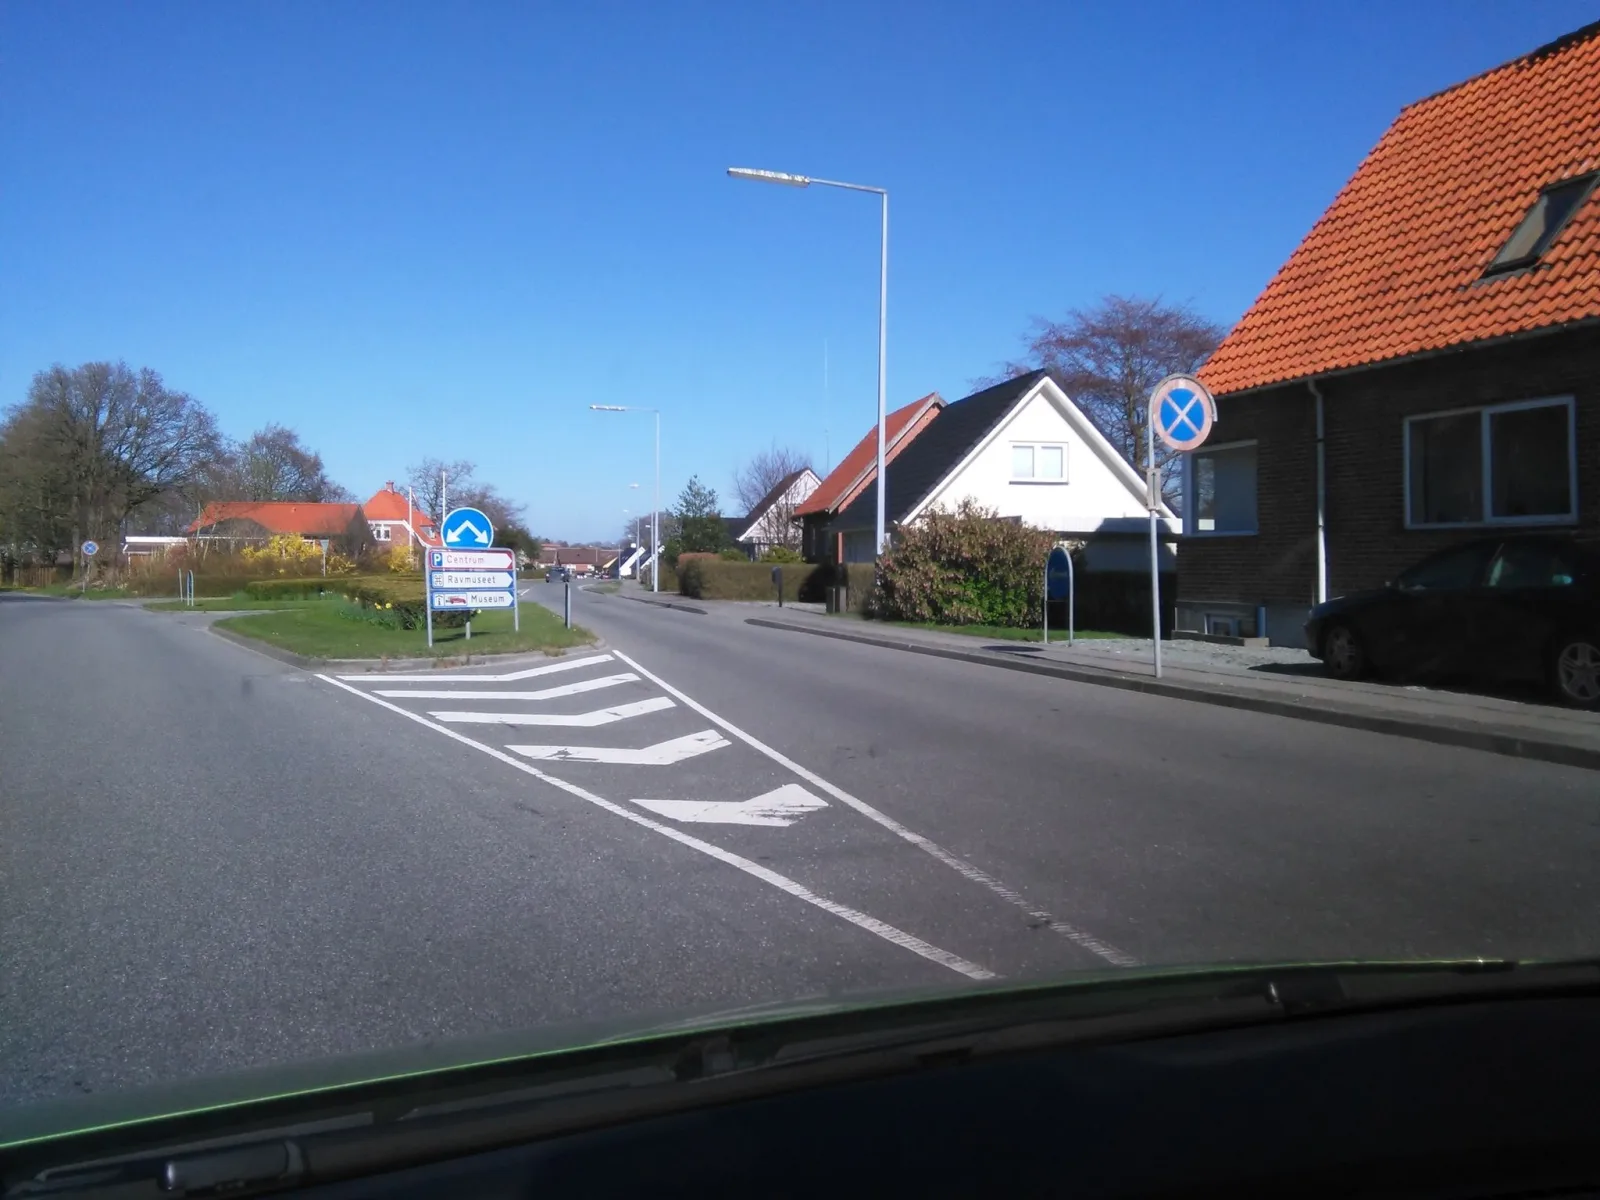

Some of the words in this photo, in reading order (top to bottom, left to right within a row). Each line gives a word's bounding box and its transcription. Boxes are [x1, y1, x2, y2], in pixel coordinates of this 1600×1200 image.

[433, 553, 441, 566] P
[446, 555, 484, 564] Centrum
[447, 575, 496, 584] Ravmuseet
[471, 595, 505, 603] Museum
